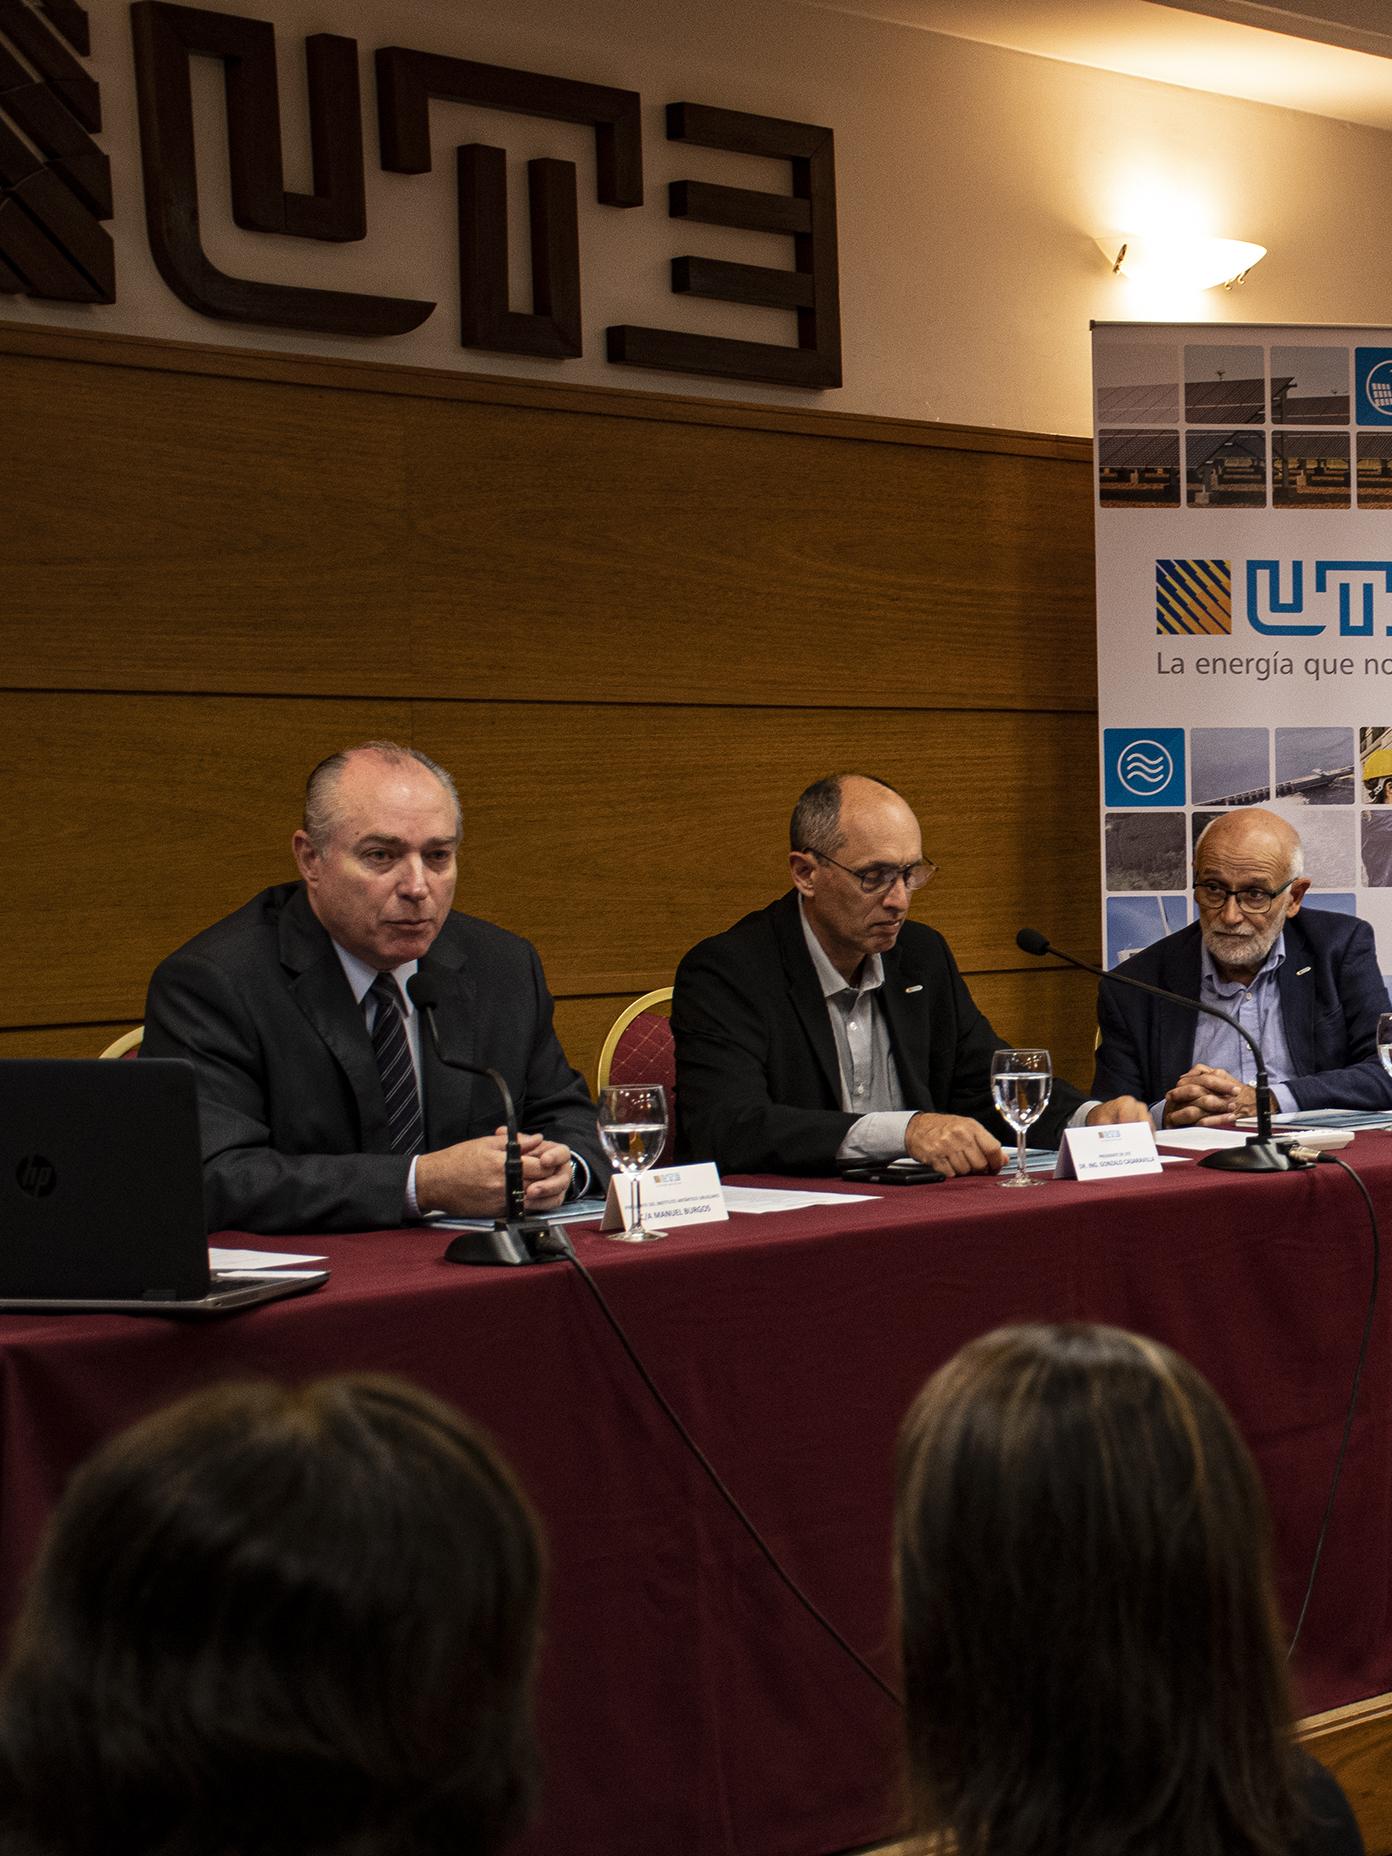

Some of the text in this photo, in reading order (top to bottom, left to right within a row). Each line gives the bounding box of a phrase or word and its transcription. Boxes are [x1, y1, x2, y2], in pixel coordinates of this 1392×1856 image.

[1156, 651, 1185, 675] La
[1195, 650, 1294, 681] energía
[1304, 655, 1355, 681] que
[653, 1208, 683, 1218] MANUEL
[683, 1204, 712, 1215] BURGOS
